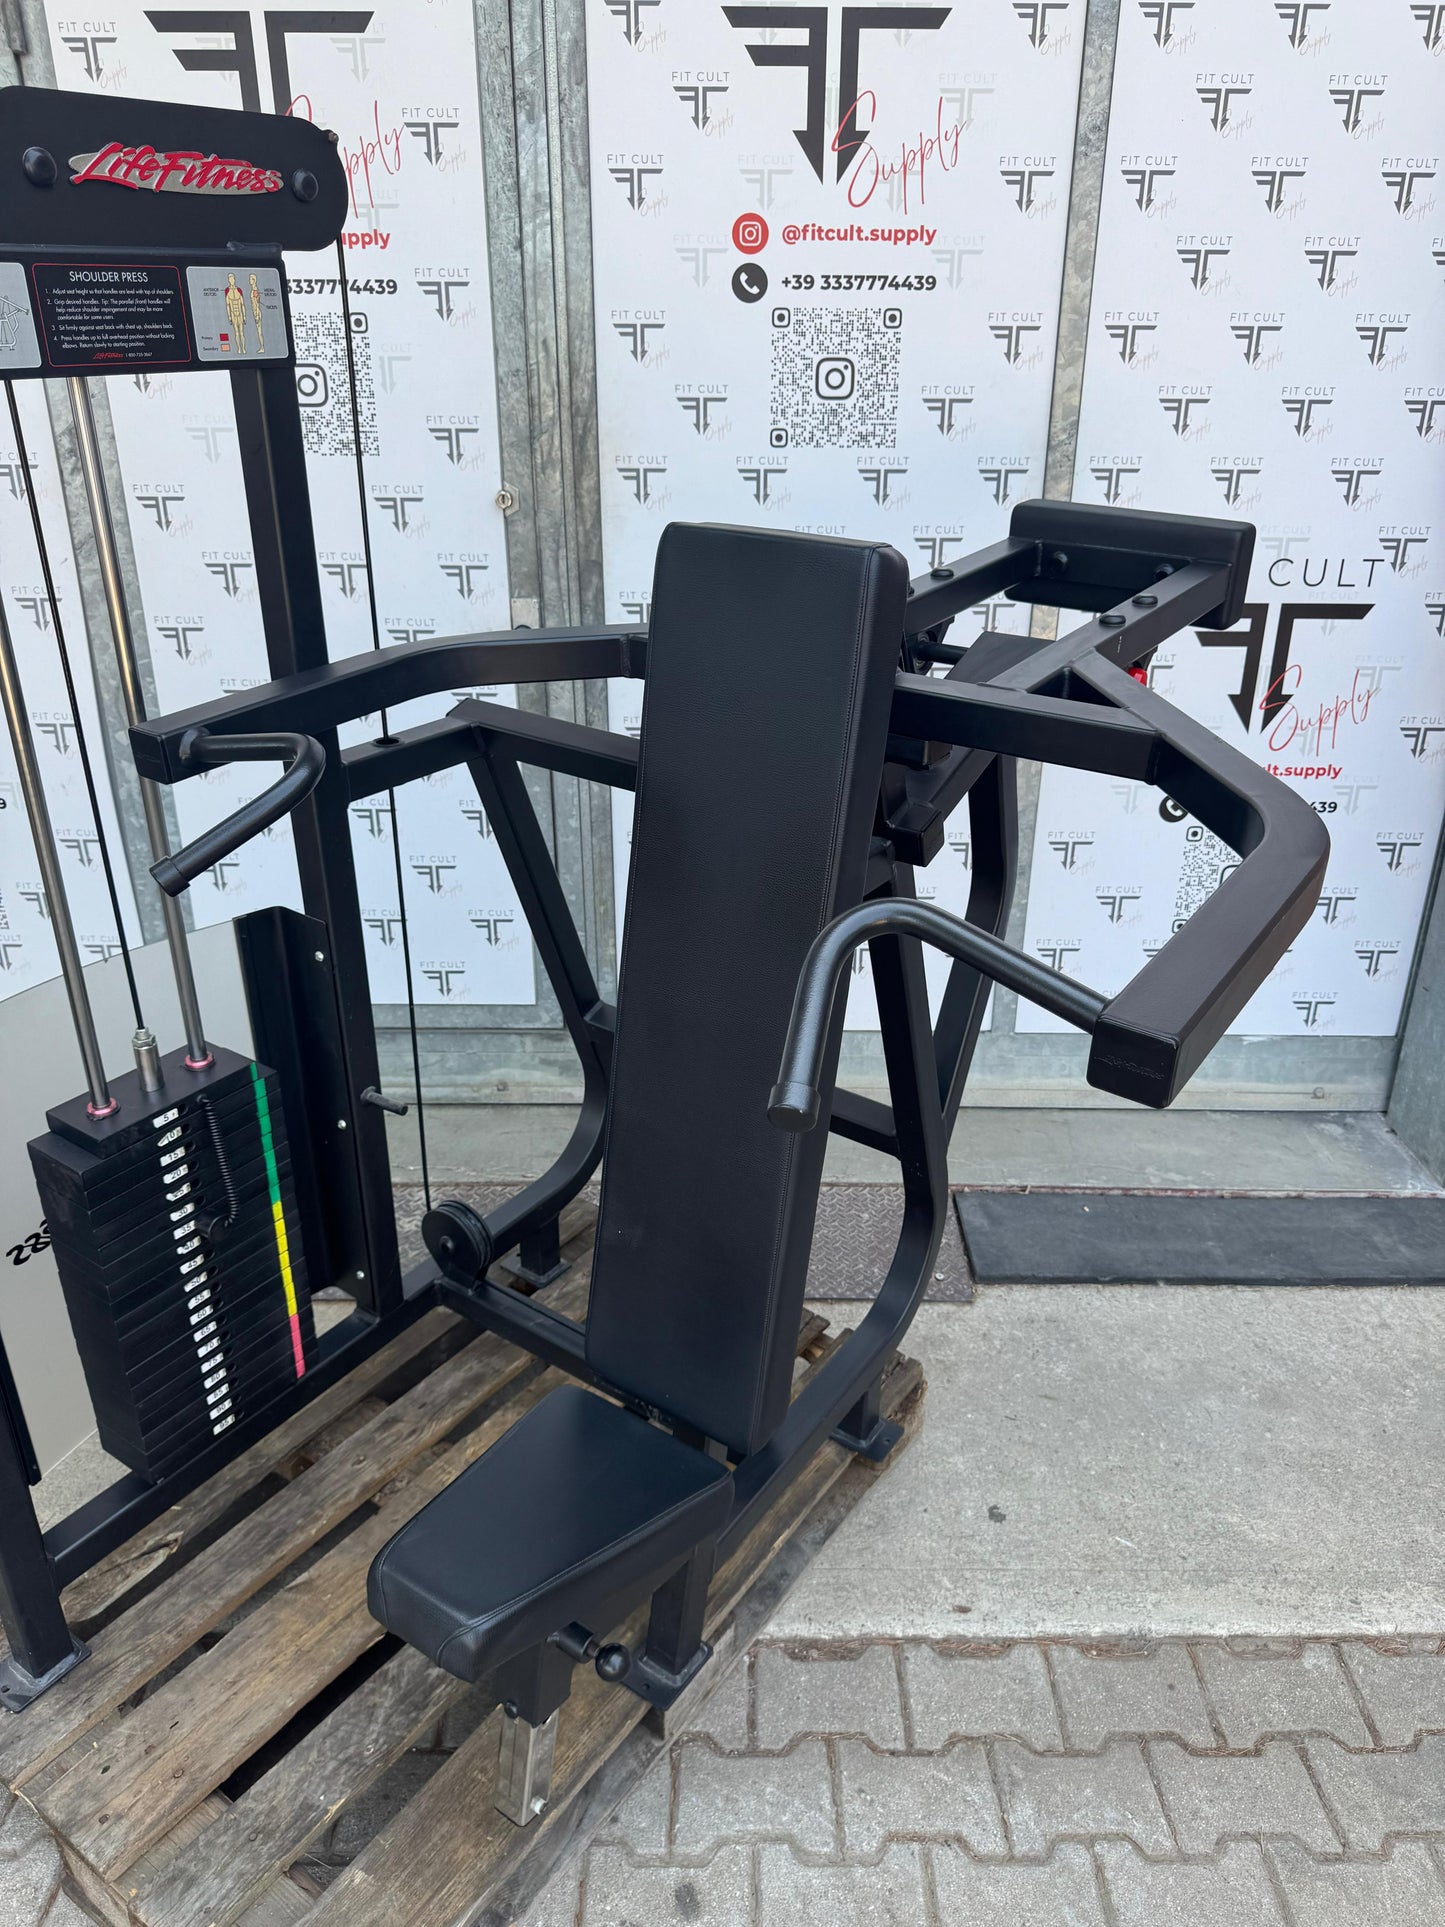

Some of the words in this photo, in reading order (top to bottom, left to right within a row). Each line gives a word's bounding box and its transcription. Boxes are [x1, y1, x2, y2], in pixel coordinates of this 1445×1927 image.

[58, 22, 76, 32] FIT
[83, 22, 116, 32] CULT
[672, 72, 691, 81] FIT
[697, 72, 730, 82] CULT
[1196, 74, 1216, 84] FIT
[1221, 74, 1254, 84] CULT
[1329, 75, 1349, 85] FIT
[1354, 75, 1388, 85] CULT
[402, 108, 420, 117] FIT
[427, 108, 459, 118] CULT
[832, 91, 967, 215] Supply
[607, 154, 625, 164] FIT
[632, 154, 664, 164] CULT
[1000, 157, 1019, 166] FIT
[1024, 157, 1056, 166] CULT
[1252, 157, 1271, 166] FIT
[1276, 157, 1309, 167] CULT
[1382, 158, 1401, 168] FIT
[1407, 159, 1439, 168] CULT
[782, 224, 937, 246] @fitcult.supply
[69, 271, 120, 282] SHOULDER
[121, 272, 149, 283] PRESS
[415, 268, 432, 277] FIT
[438, 268, 469, 277] CULT
[781, 275, 815, 291] +39
[820, 275, 937, 292] 3337774439
[1356, 314, 1374, 322] FIT
[1379, 314, 1411, 323] CULT
[921, 386, 939, 394] FIT
[944, 386, 975, 395] CULT
[426, 416, 443, 424] FIT
[449, 416, 479, 424] CULT
[736, 456, 753, 465] FIT
[759, 456, 788, 465] CULT
[1331, 458, 1349, 466] FIT
[1354, 458, 1384, 467] CULT
[133, 484, 150, 493] FIT
[155, 484, 184, 493] CULT
[371, 485, 388, 494] FIT
[394, 485, 424, 494] CULT
[1379, 526, 1397, 534] FIT
[1401, 527, 1431, 535] CULT
[437, 553, 454, 561] FIT
[459, 553, 488, 562] CULT
[1268, 558, 1385, 587] CULT
[154, 616, 170, 624] FIT
[175, 616, 204, 624] CULT
[1259, 664, 1381, 756] Supply
[1048, 831, 1064, 839] FIT
[1068, 831, 1096, 839] CULT
[1397, 832, 1424, 840] CULT
